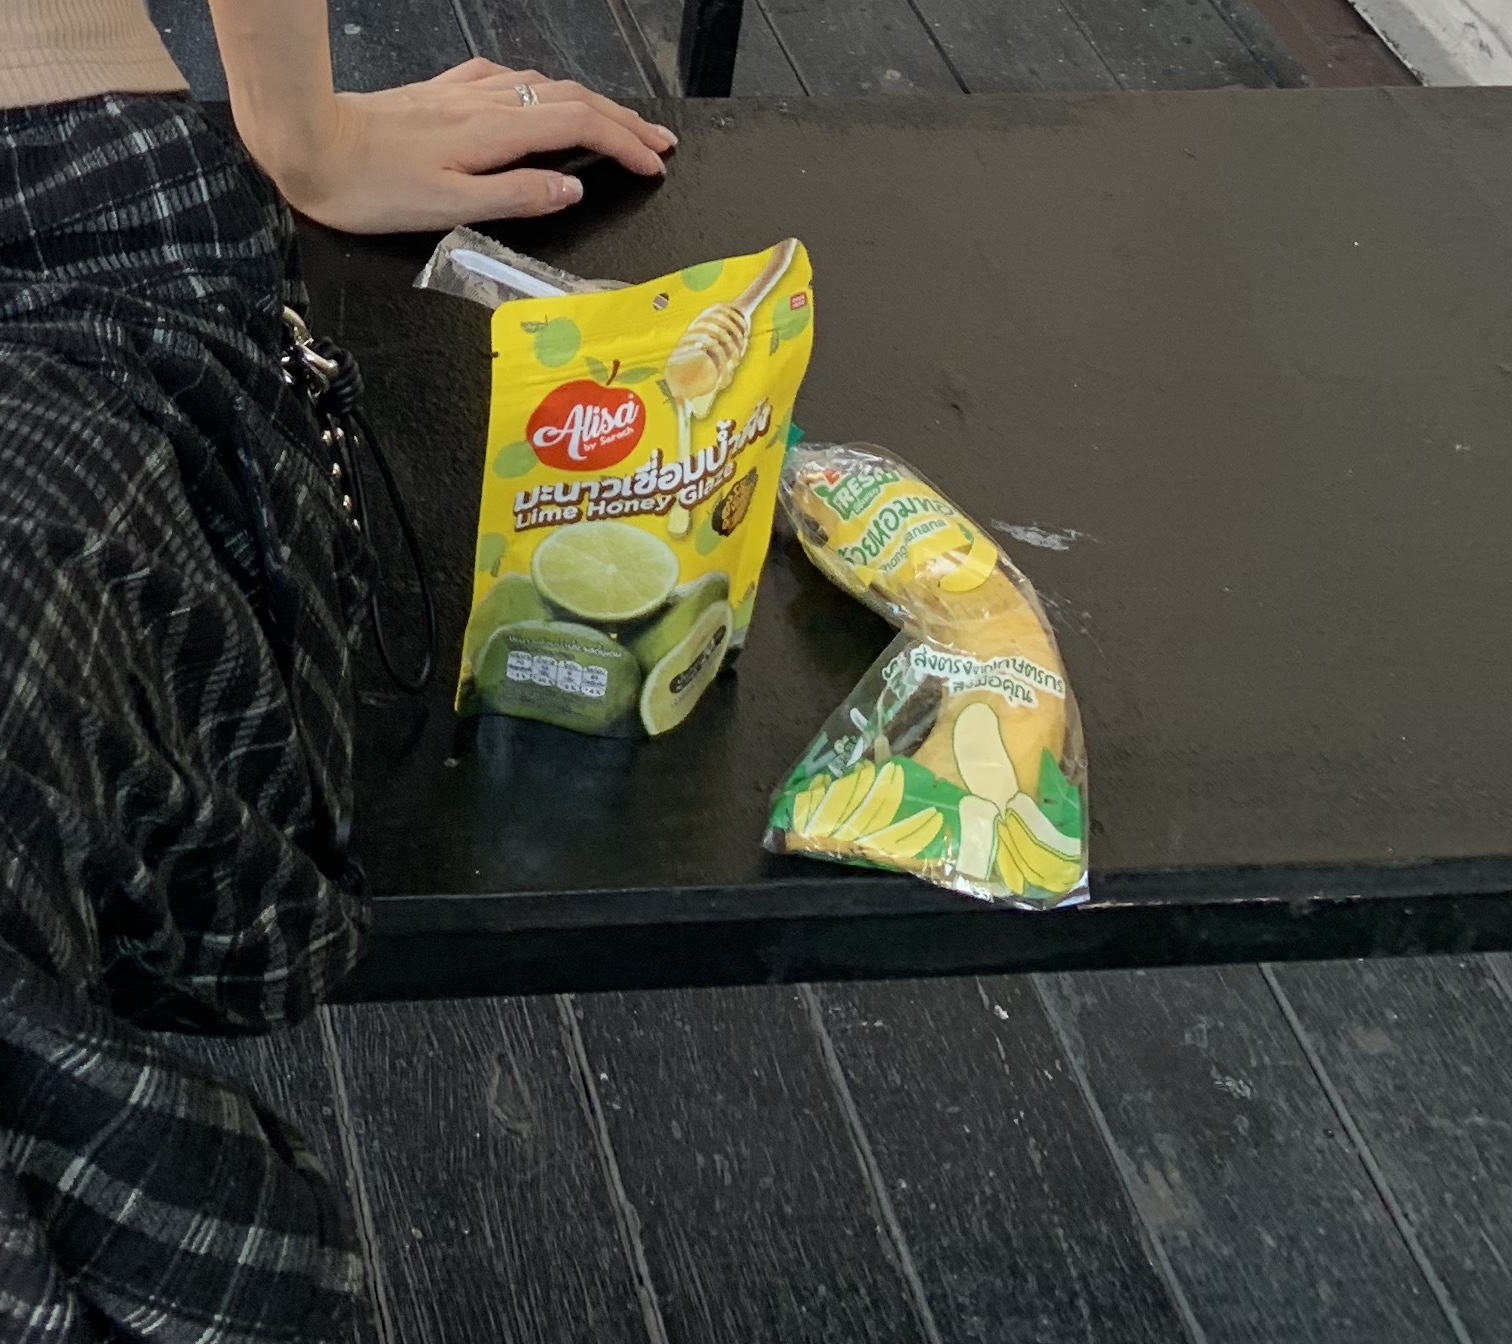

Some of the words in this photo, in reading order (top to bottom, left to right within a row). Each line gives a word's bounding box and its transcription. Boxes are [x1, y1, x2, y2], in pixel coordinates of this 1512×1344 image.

[532, 403, 639, 461] Alisa
[583, 441, 597, 453] by
[516, 504, 577, 529] Lime
[587, 495, 673, 517] Honey
[679, 464, 734, 505] Glaze
[905, 519, 947, 542] anana
